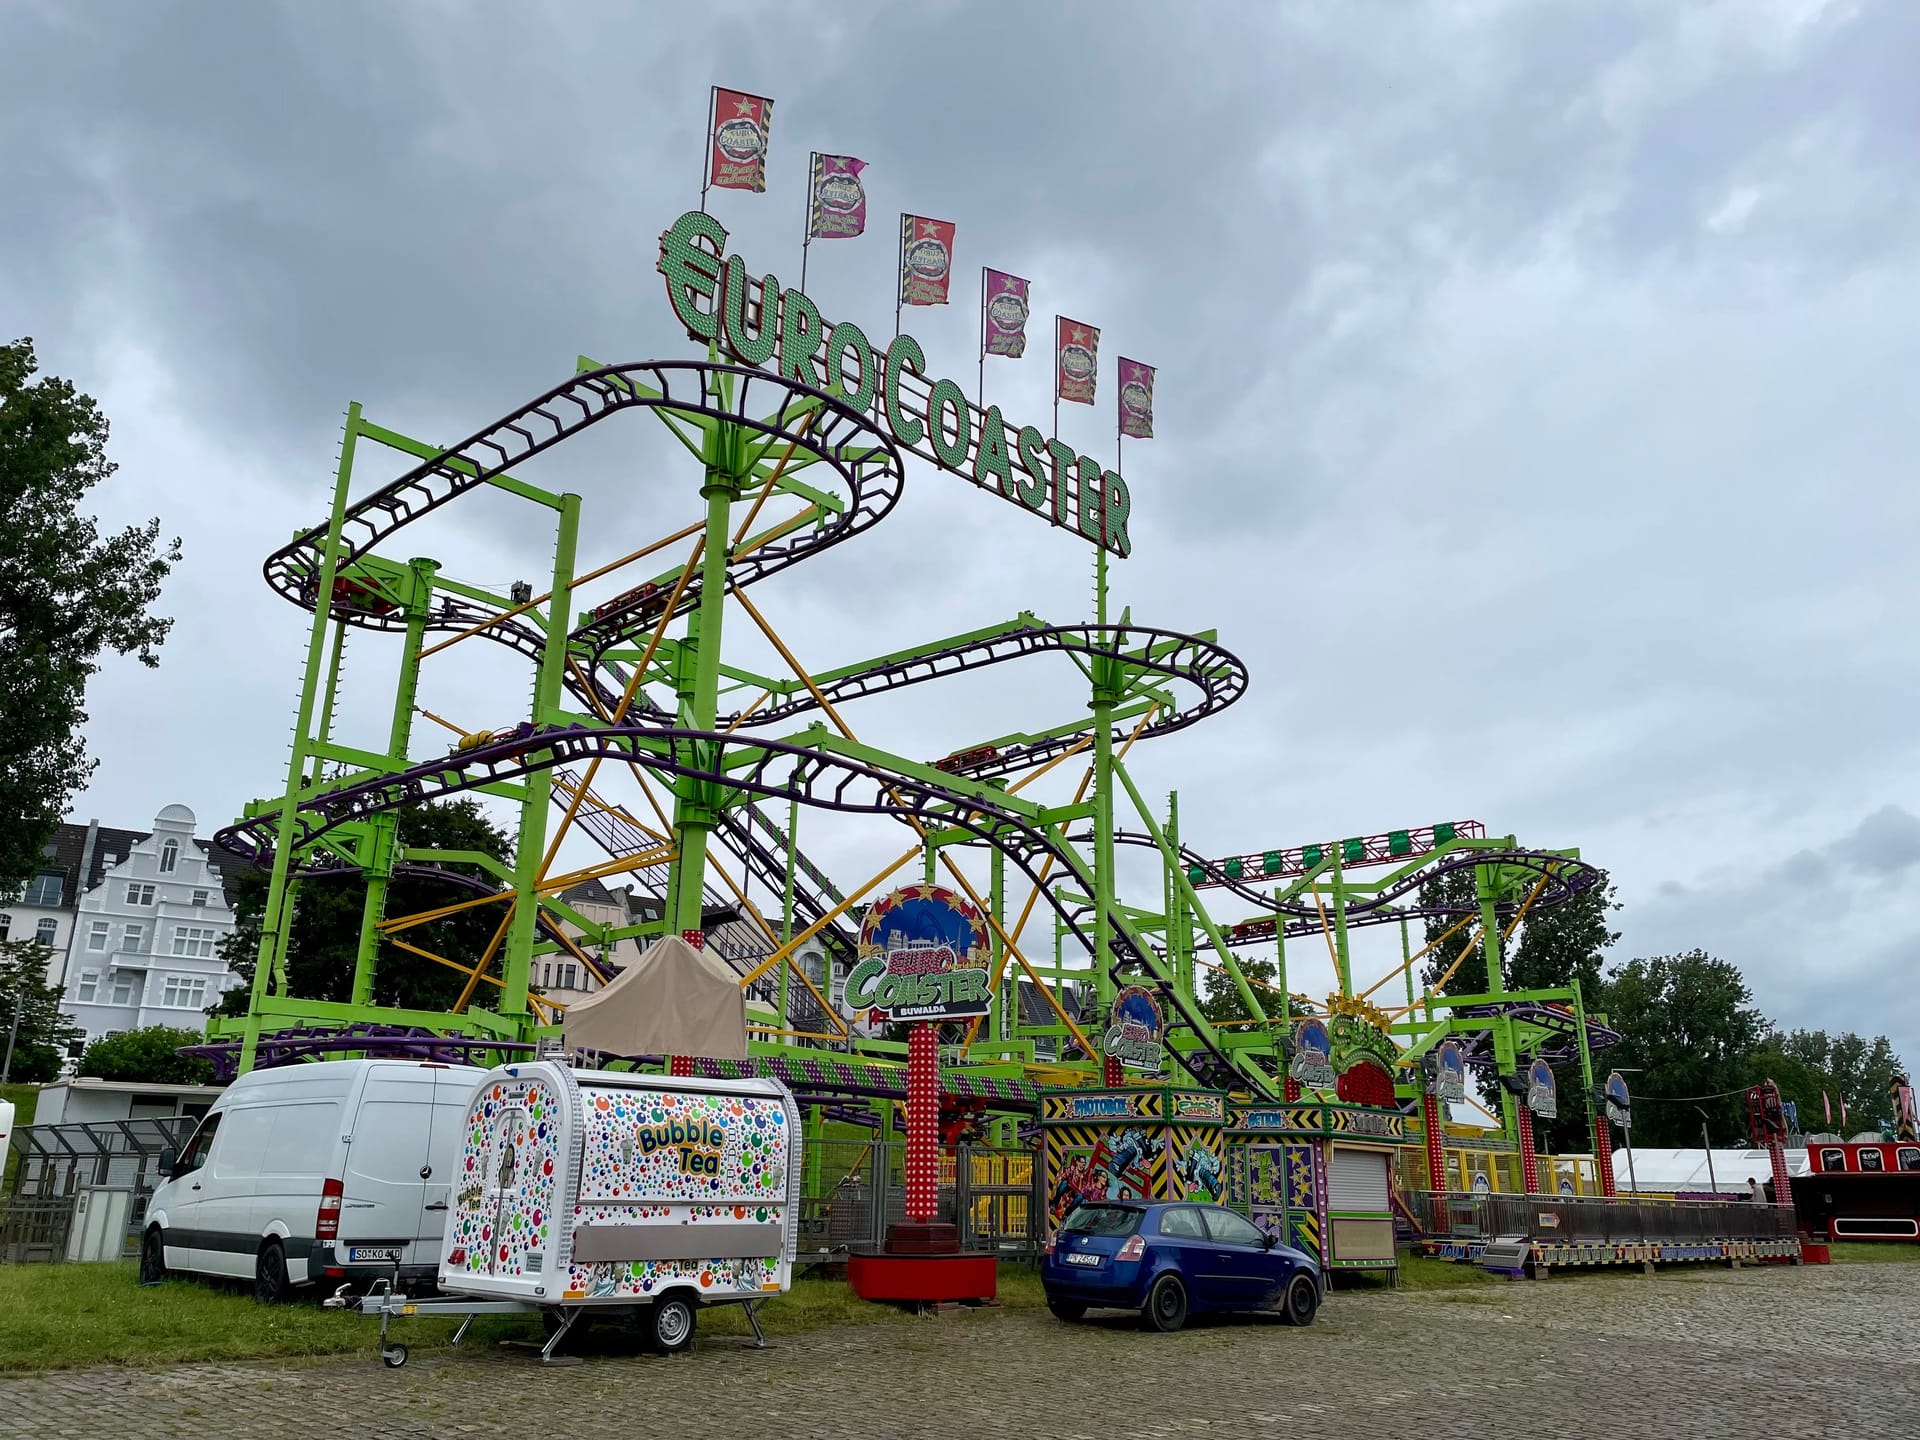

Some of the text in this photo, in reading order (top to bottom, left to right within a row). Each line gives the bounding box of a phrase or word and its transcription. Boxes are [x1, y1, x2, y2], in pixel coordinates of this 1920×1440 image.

[888, 947, 953, 976] EURO
[844, 957, 990, 1008] COASTER
[900, 1004, 946, 1016] BUWALDA
[639, 1118, 724, 1153] Bubble
[679, 1147, 719, 1174] Tea
[457, 1184, 483, 1206] Bubble
[468, 1199, 481, 1210] Tea
[356, 1249, 367, 1259] SO
[1439, 1244, 1465, 1257] JOIN
